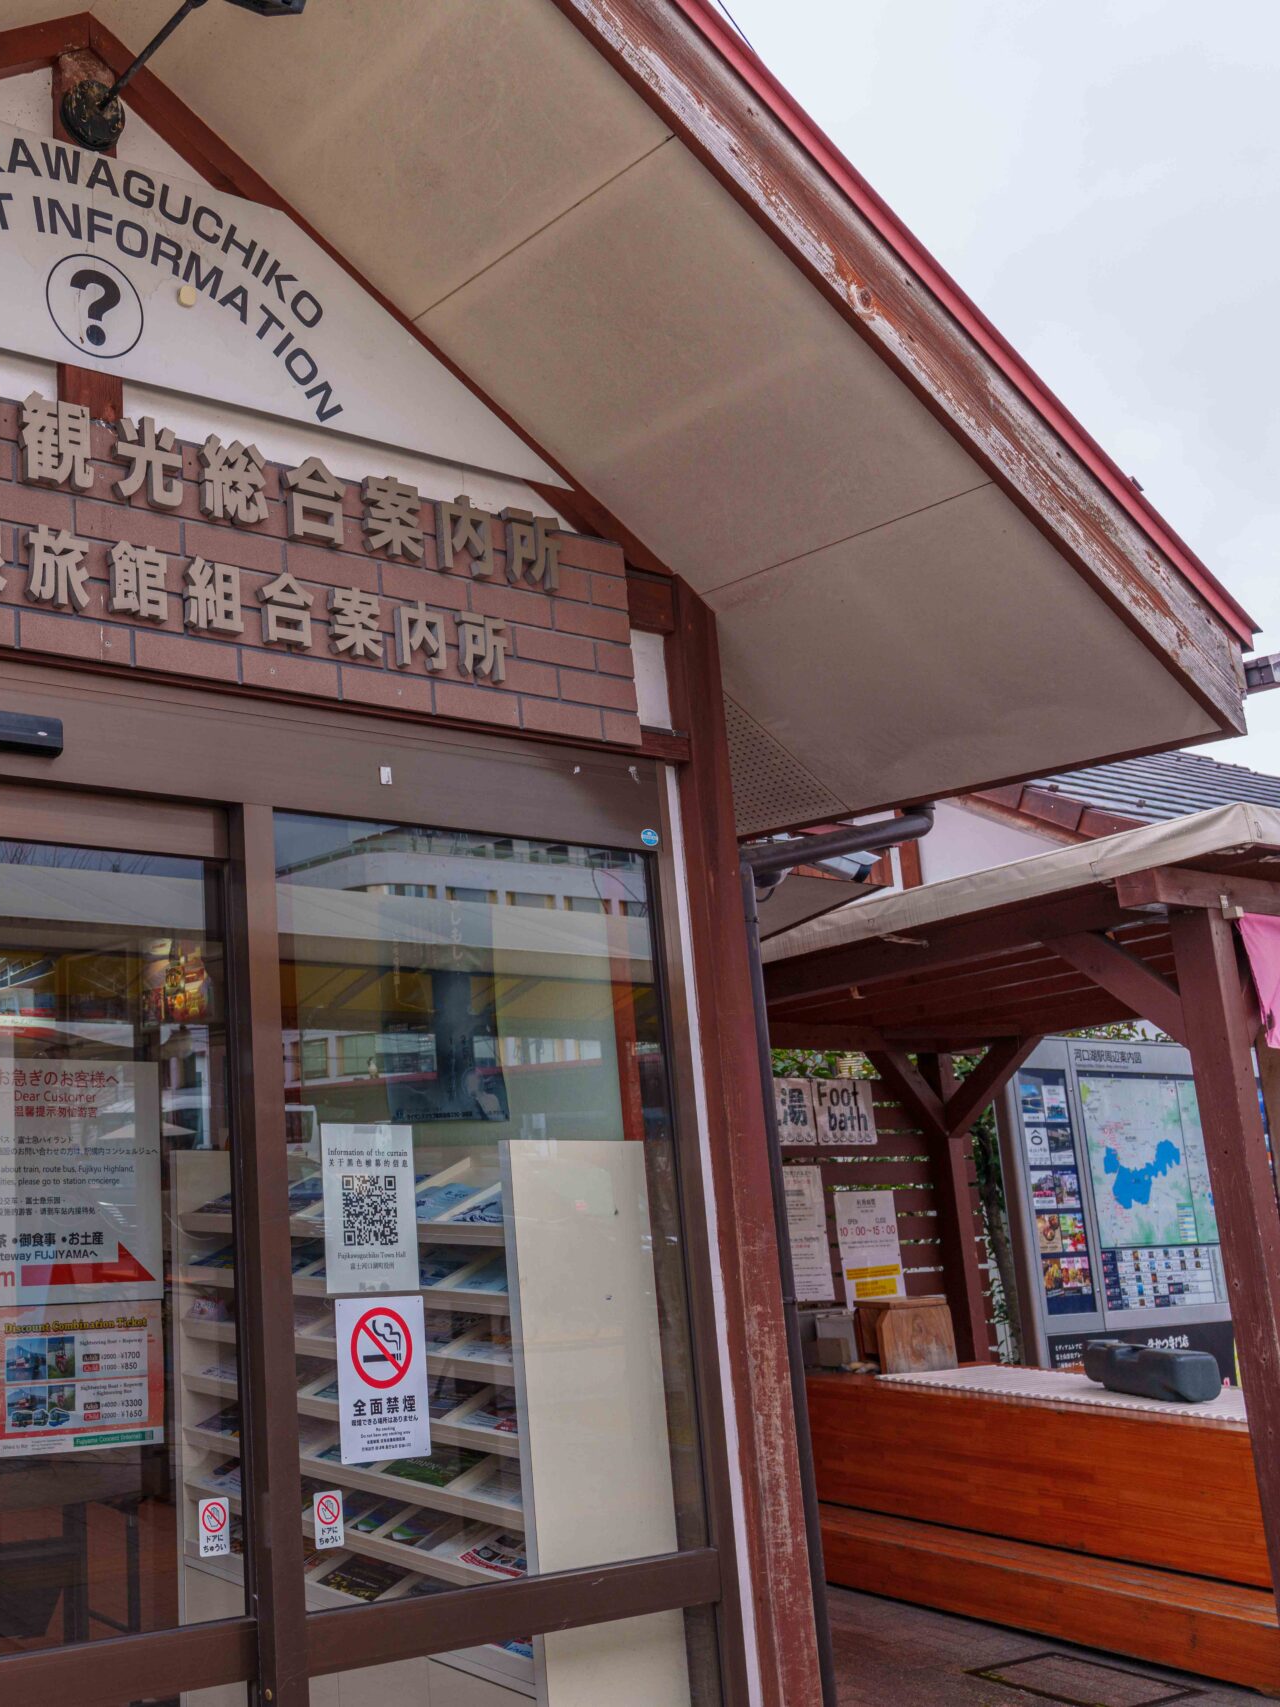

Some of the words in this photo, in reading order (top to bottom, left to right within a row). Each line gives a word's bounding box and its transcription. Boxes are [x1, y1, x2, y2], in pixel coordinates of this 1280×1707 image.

[33, 197, 345, 423] INFORMATION
[1073, 1048, 1143, 1064] 河口湖駅周辺案内図
[14, 1090, 40, 1101] Dear
[43, 1090, 96, 1102] Customer
[817, 1080, 859, 1107] Foot
[778, 1087, 808, 1127] 湯
[828, 1105, 868, 1131] bath
[327, 1148, 365, 1157] Information
[367, 1148, 373, 1157] of
[375, 1148, 385, 1157] the
[386, 1149, 408, 1157] curtain
[1, 1165, 21, 1173] about
[43, 1165, 61, 1173] route
[78, 1164, 102, 1175] Fujikyu
[18, 1178, 40, 1187] please
[19, 1232, 56, 1247] 御食事
[68, 1231, 104, 1246] お土産
[34, 1249, 98, 1261] FUJIYAMAへ
[4, 1321, 51, 1334] Discount
[52, 1319, 115, 1332] Combination
[116, 1316, 148, 1328] Ticket
[353, 1395, 416, 1417] 全面禁煙
[351, 1414, 419, 1427] 喫煙できる場所はありません
[321, 1526, 338, 1535] ドアに
[205, 1533, 224, 1543] ドアに
[318, 1535, 341, 1545] ちゅうい
[202, 1543, 227, 1554] ちゅうい
